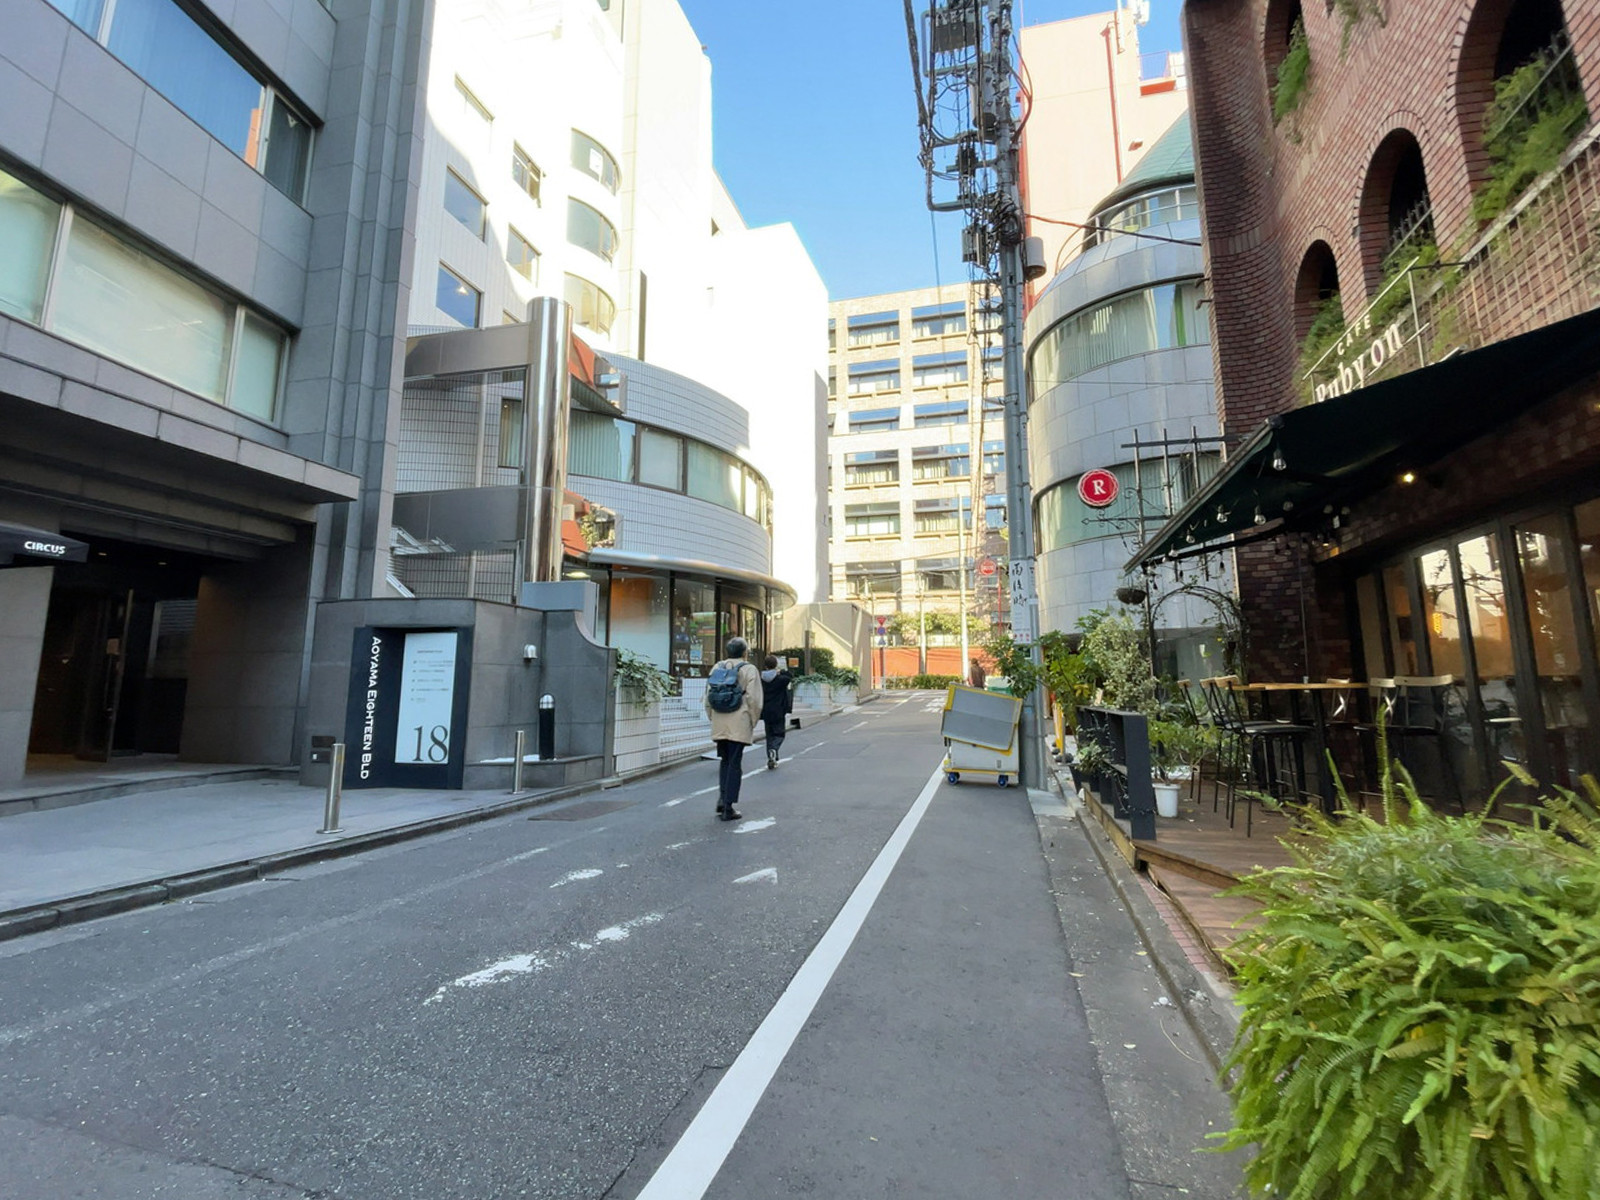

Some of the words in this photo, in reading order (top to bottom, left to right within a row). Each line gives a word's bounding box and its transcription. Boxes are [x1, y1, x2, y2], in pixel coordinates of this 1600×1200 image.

[1337, 314, 1371, 355] CAFE
[1092, 479, 1107, 495] R
[24, 541, 66, 554] CIRCUS
[368, 636, 382, 688] AOYAMA
[362, 690, 377, 751] EIGHTEEN
[412, 725, 448, 762] 18
[360, 753, 372, 780] BLD
